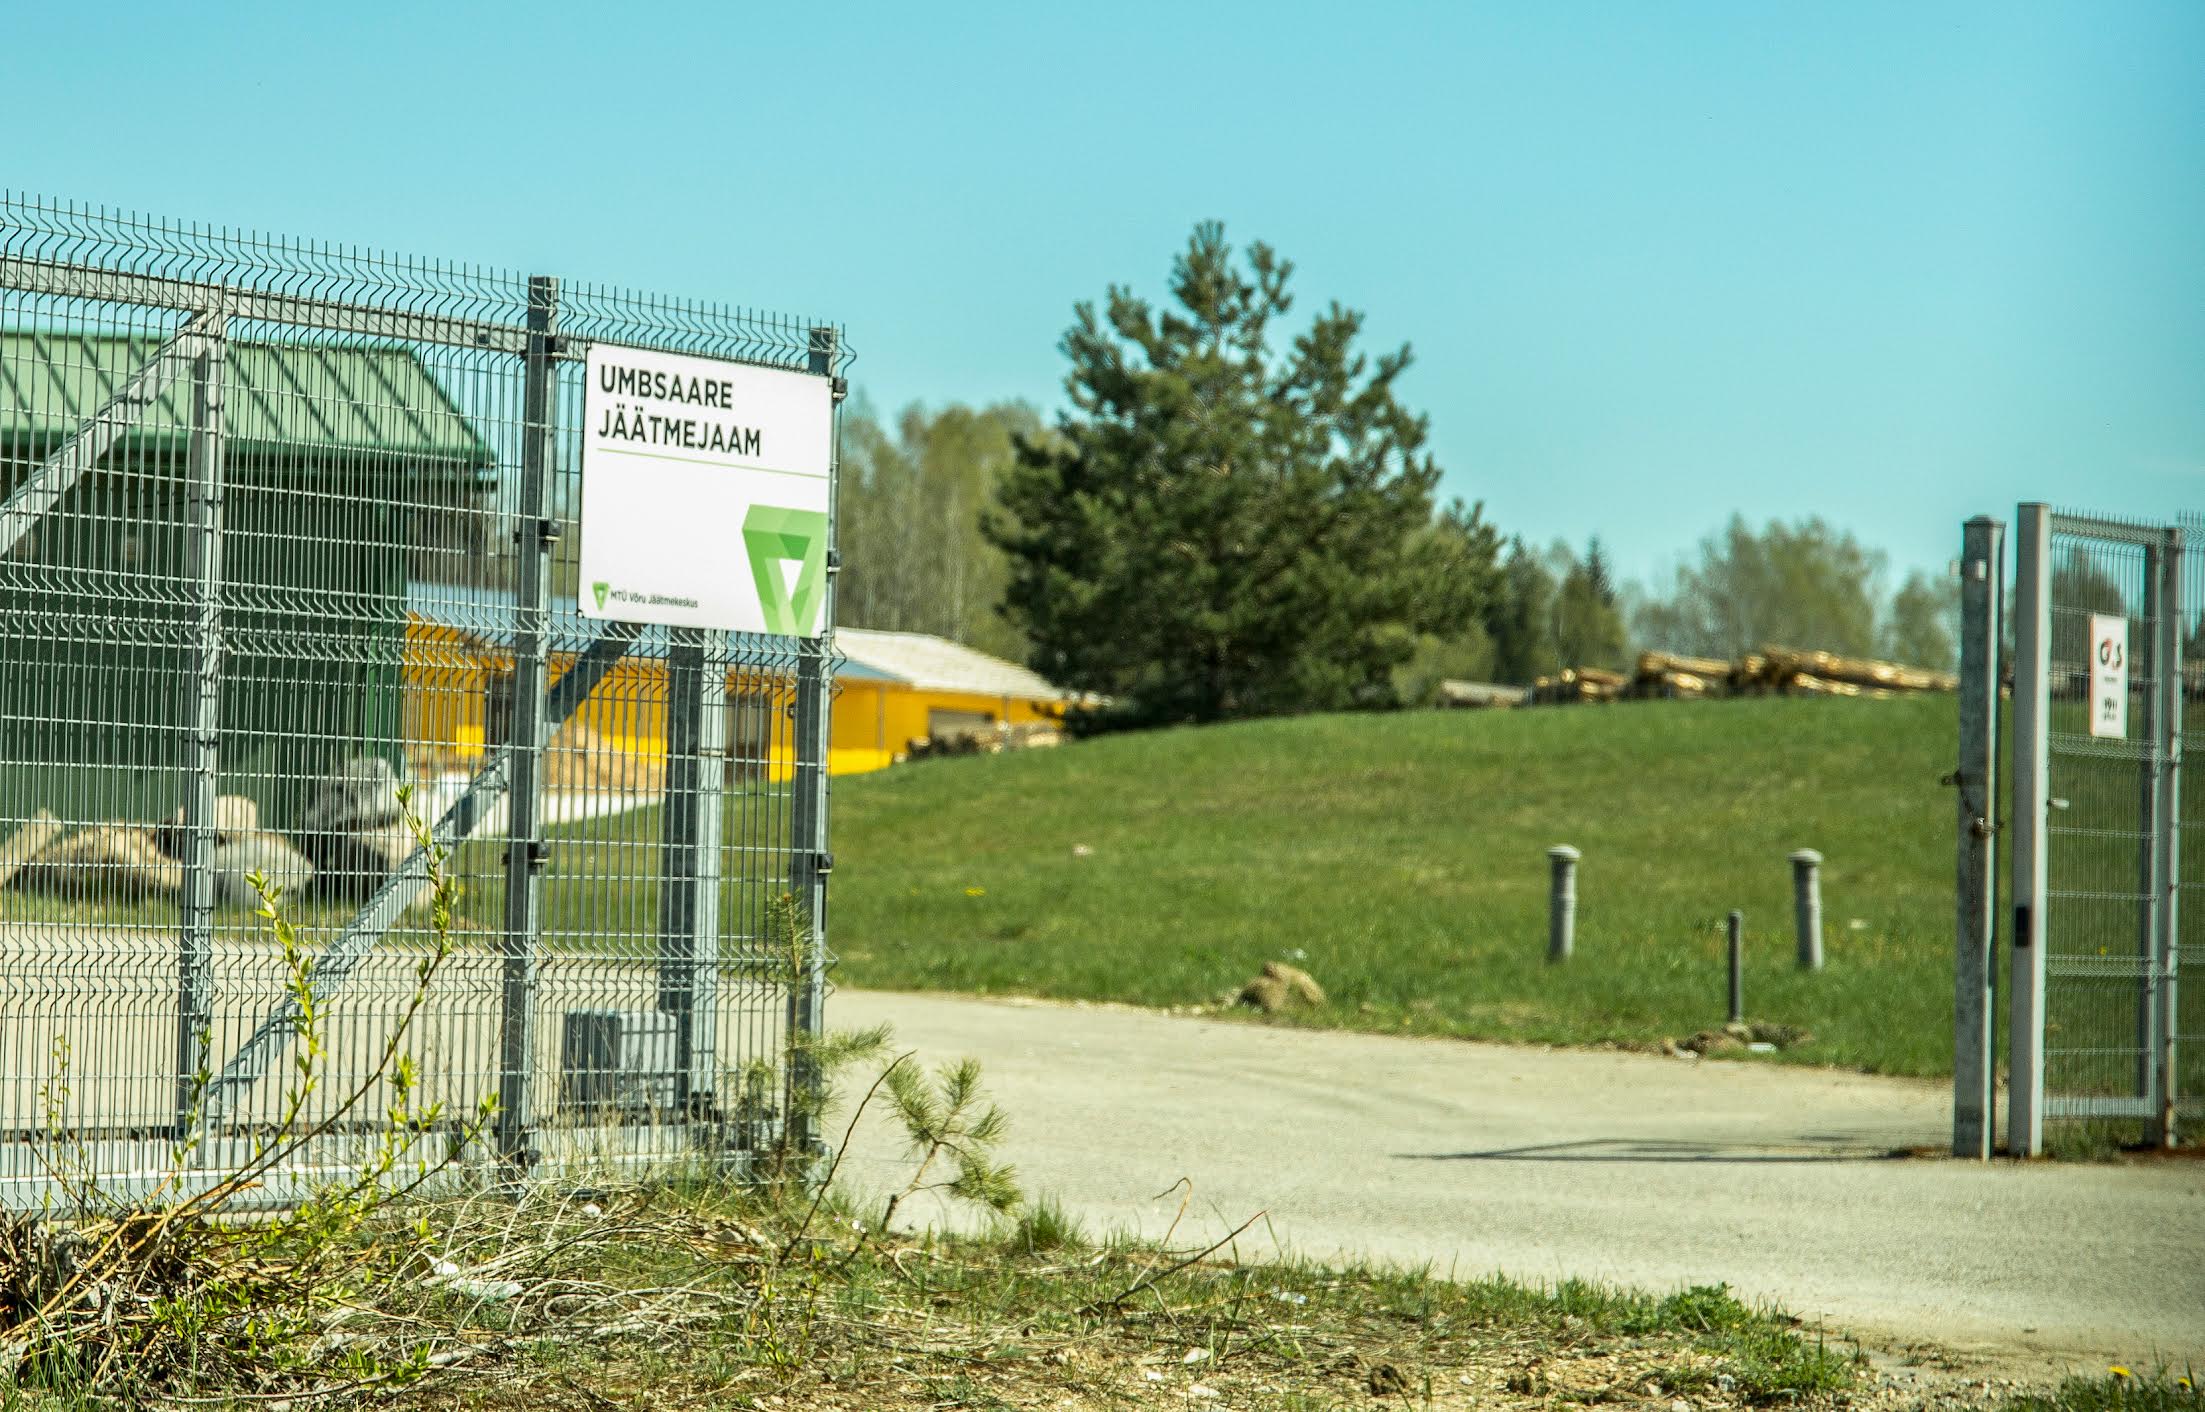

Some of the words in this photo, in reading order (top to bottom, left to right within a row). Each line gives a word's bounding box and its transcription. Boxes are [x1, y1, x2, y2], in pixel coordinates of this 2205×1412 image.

[600, 364, 733, 409] UMBSAARE
[599, 403, 761, 457] JÄÄTMEJAAM
[611, 590, 627, 602] MTÜ
[629, 592, 646, 604] Võru
[648, 594, 698, 608] Jäätmekeskus
